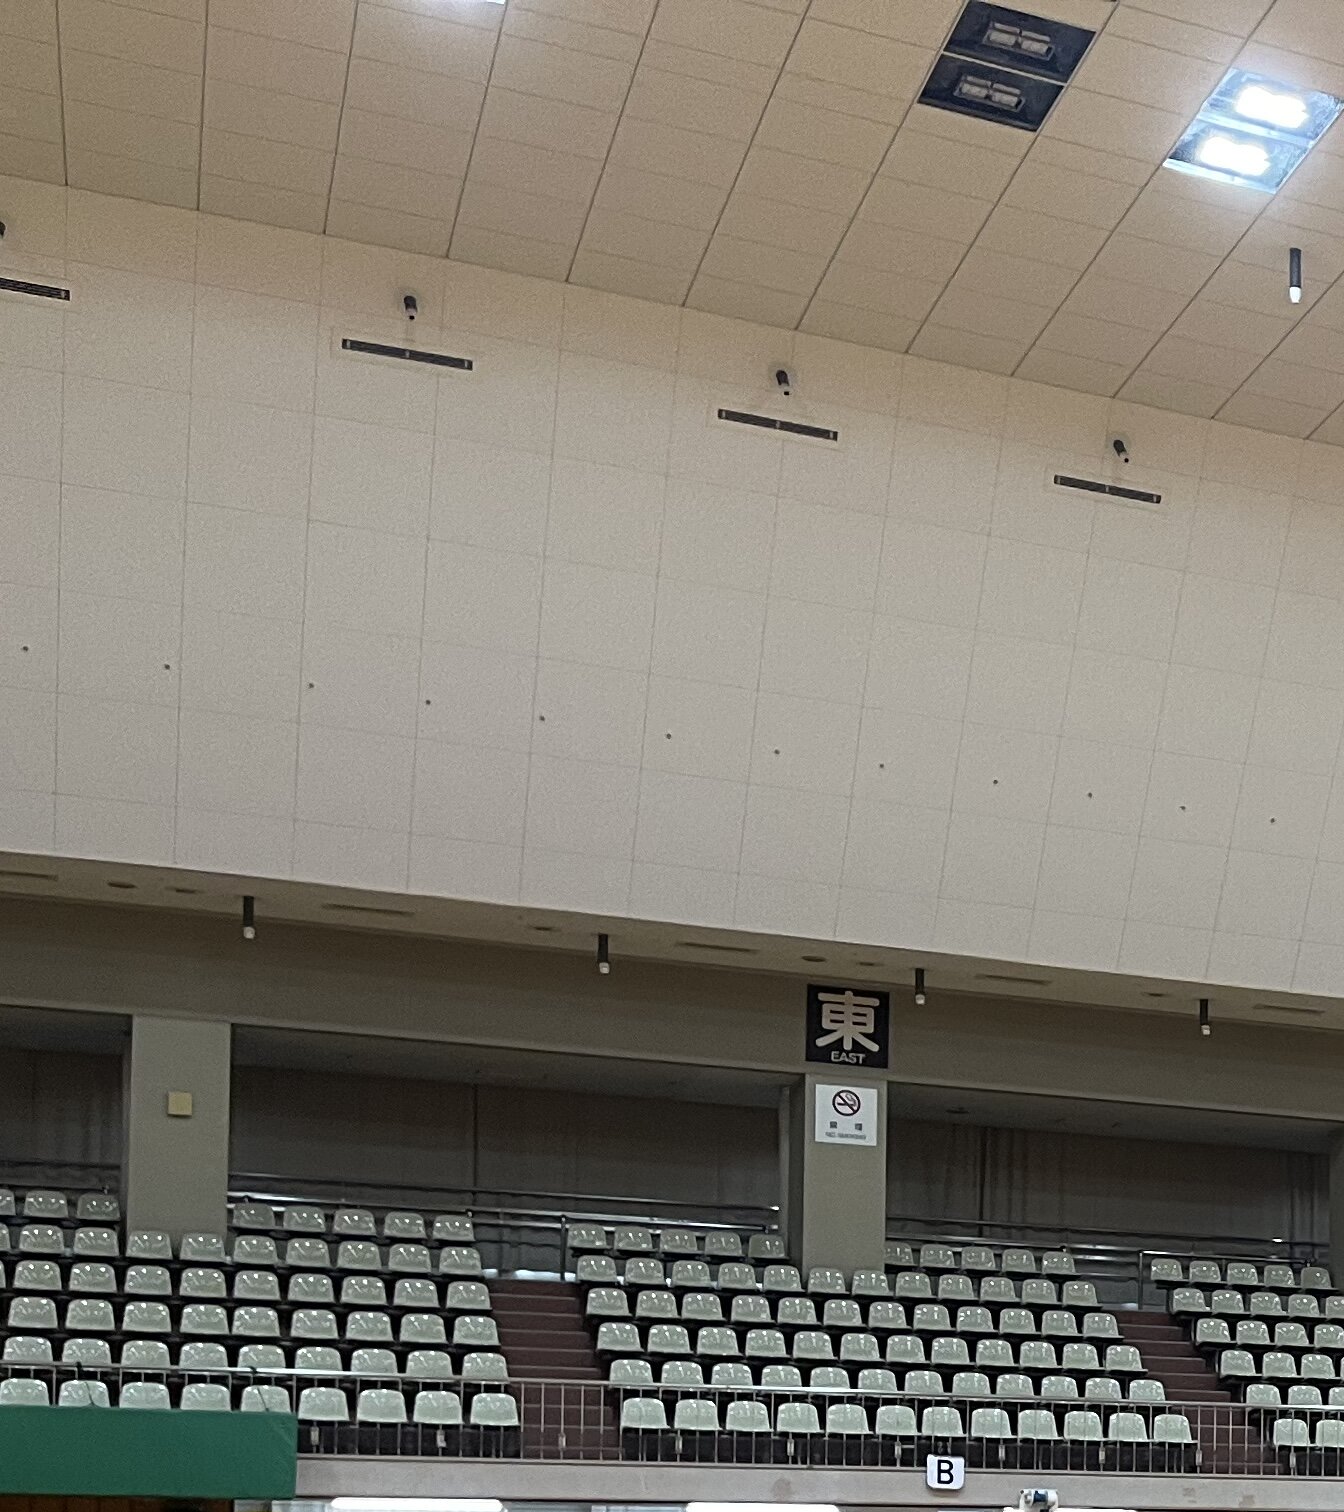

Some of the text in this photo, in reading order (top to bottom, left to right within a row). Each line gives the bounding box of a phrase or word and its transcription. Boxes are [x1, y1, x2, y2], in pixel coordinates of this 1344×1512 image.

[816, 990, 880, 1052] 東
[830, 1051, 866, 1065] EAST
[937, 1459, 954, 1485] B
